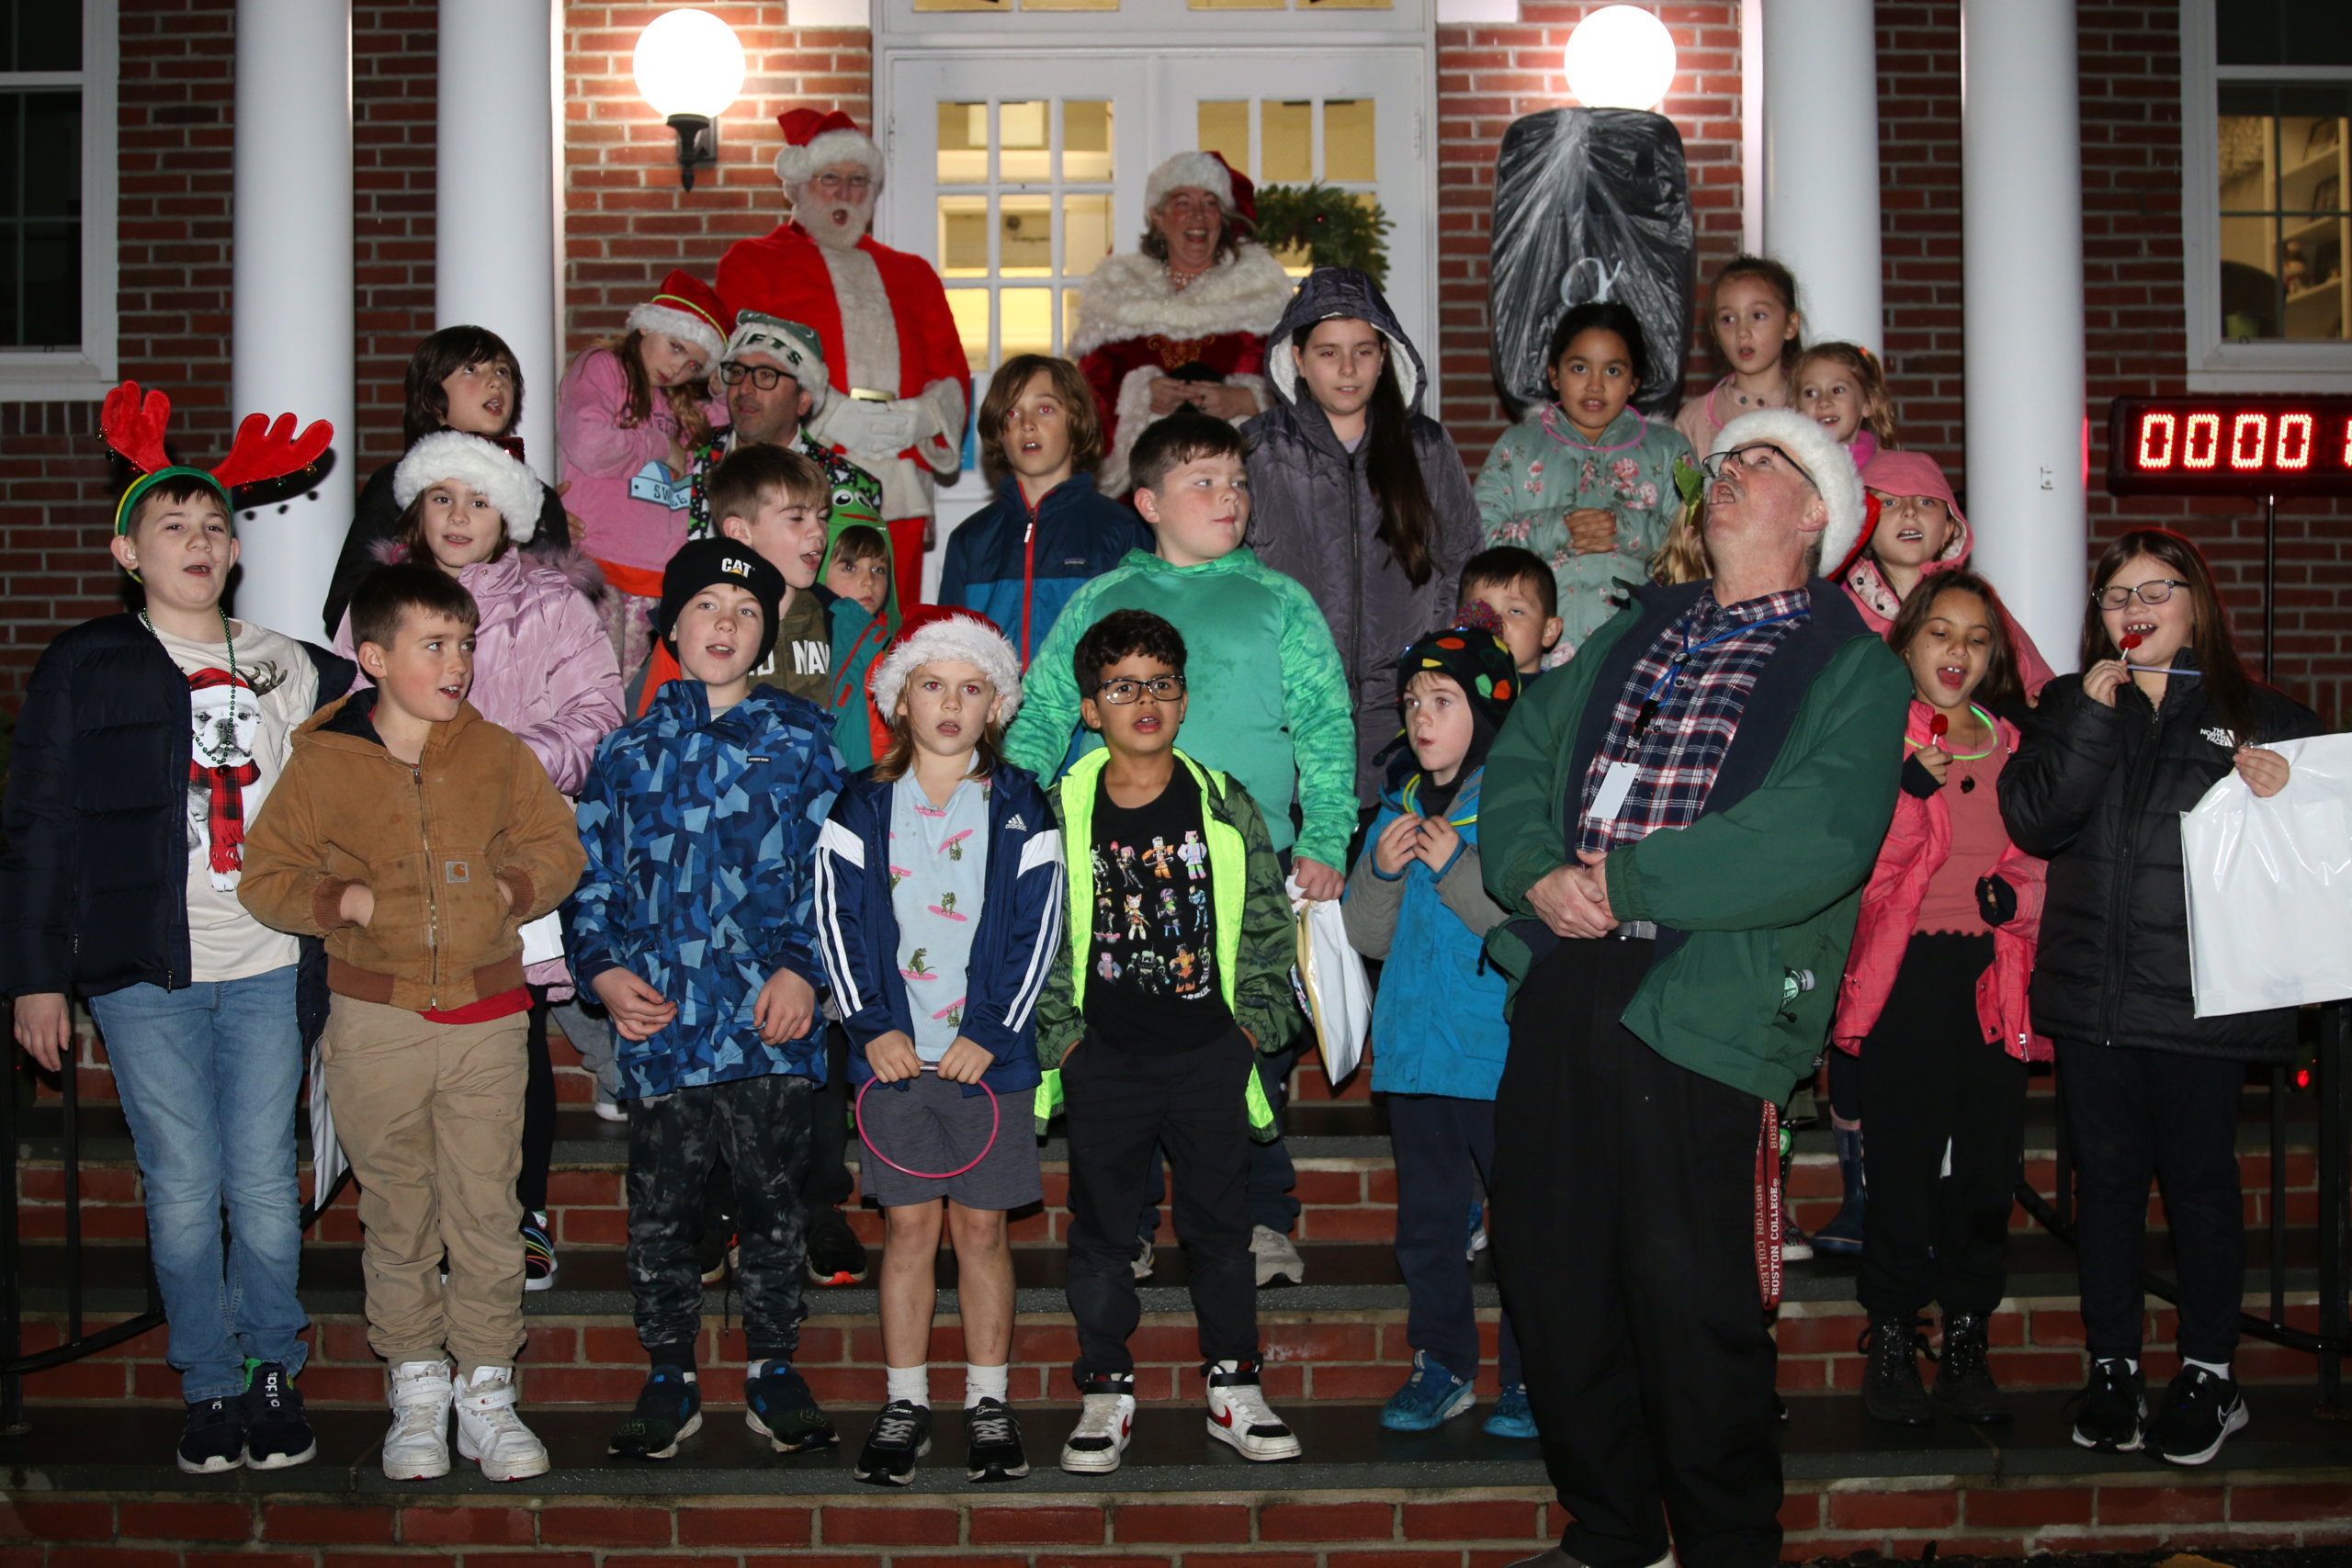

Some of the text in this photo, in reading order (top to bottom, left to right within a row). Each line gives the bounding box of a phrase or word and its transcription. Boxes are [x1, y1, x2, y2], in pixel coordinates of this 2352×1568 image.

[736, 332, 803, 367] ETS
[721, 558, 752, 578] CAT
[792, 639, 831, 675] NAV
[2199, 728, 2226, 741] NORTH
[2206, 735, 2226, 746] FACE
[2212, 727, 2225, 735] THE
[1756, 1185, 1764, 1235] BOSTON
[1771, 1245, 1780, 1296] BOSTON
[266, 1371, 280, 1407] adas
